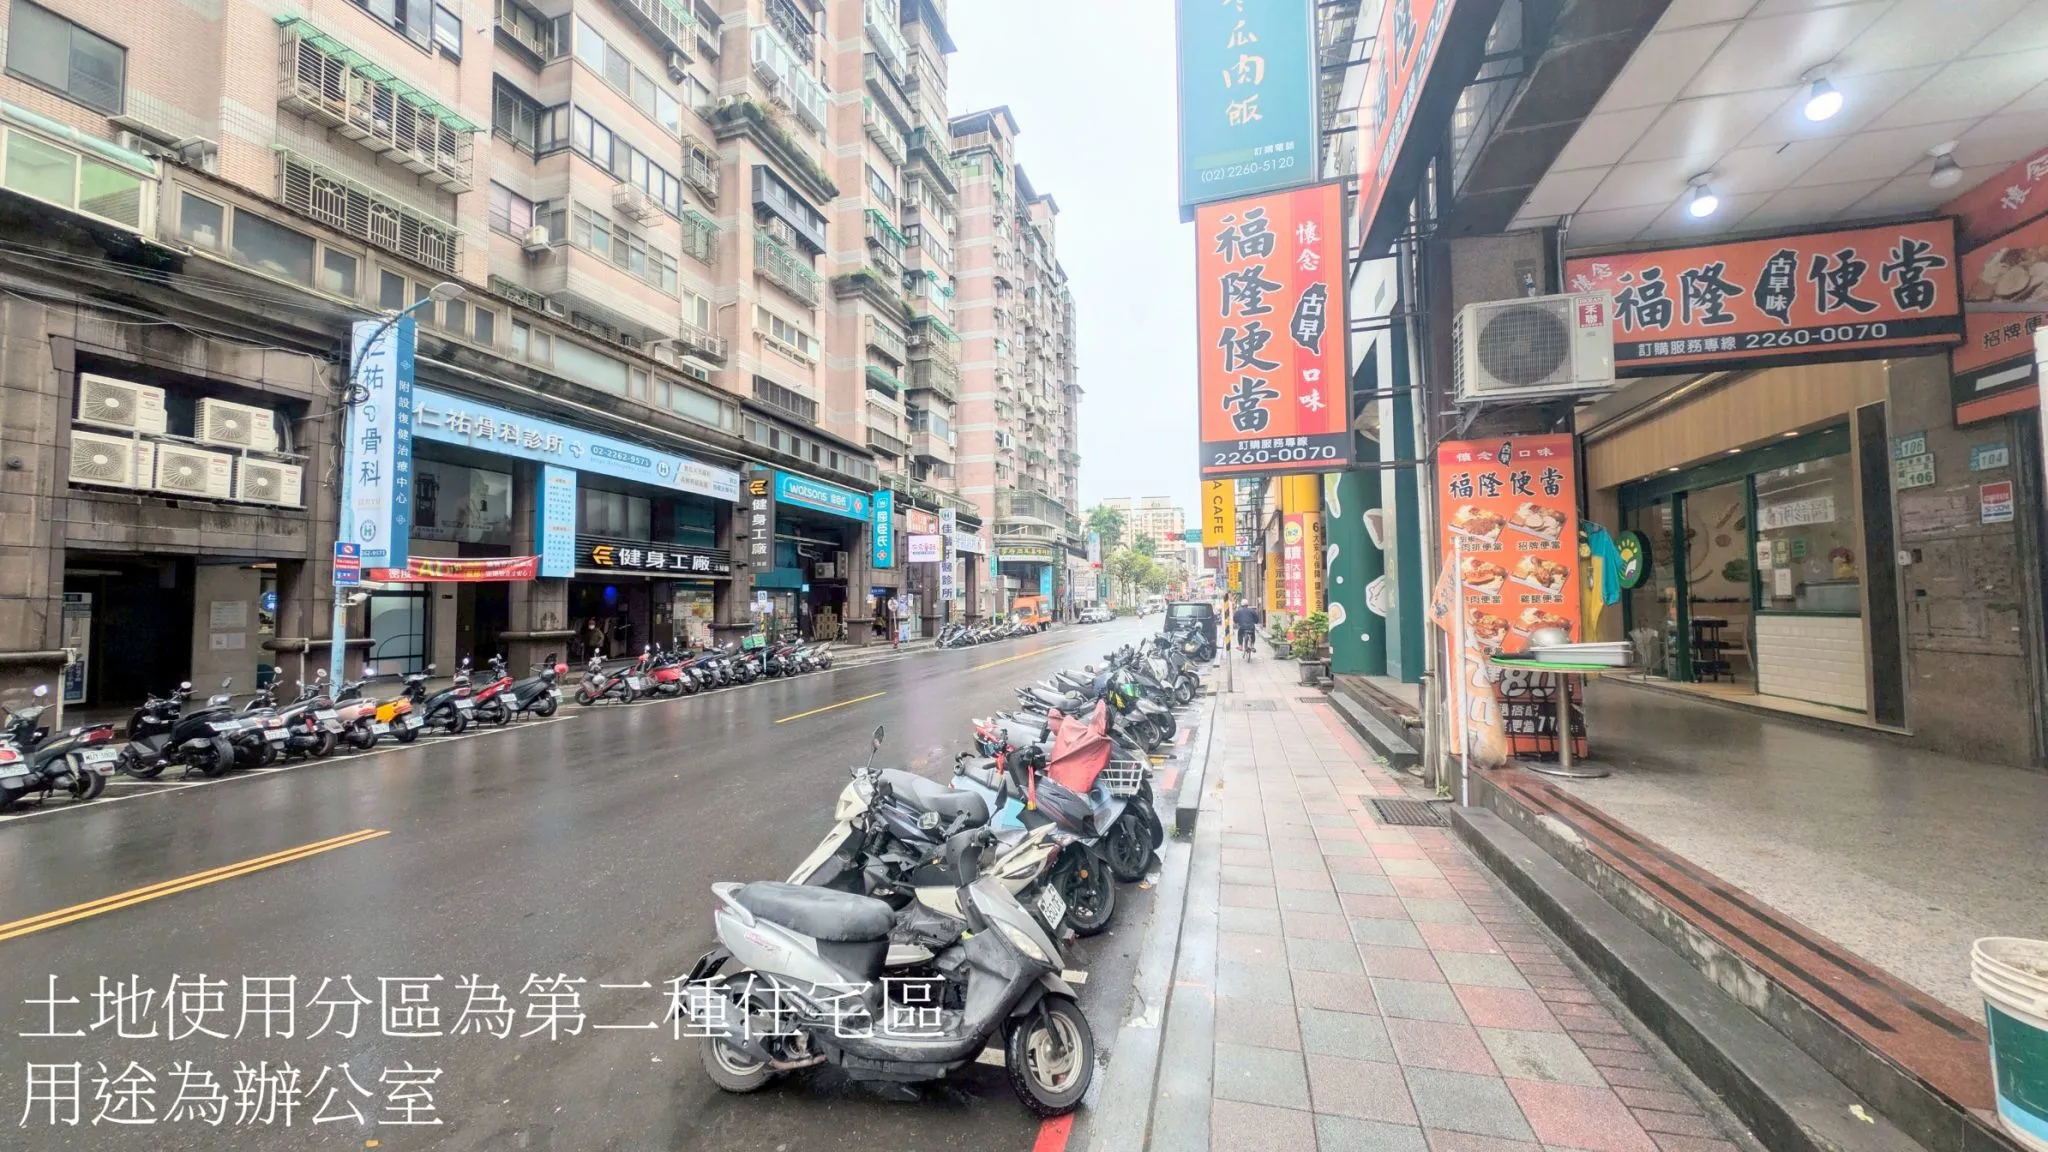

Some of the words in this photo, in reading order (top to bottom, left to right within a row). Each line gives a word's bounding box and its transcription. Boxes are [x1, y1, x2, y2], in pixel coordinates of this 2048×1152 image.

[1254, 141, 1294, 156] 訂購電話
[1201, 156, 1295, 182] (02)2260-5120
[1296, 220, 1321, 271] 懷念
[1614, 261, 1745, 333] 福隆
[1806, 236, 1949, 315] 便當
[1765, 257, 1792, 311] 古早味
[1214, 207, 1284, 432] 福隆便當
[1297, 294, 1324, 341] 古早
[1638, 339, 1736, 358] 訂購服務專線
[1745, 323, 1888, 349] 2260-0070
[1299, 368, 1326, 412] 口味
[413, 401, 564, 456] 仁祐骨科診所
[1215, 446, 1336, 466] 2260-0070
[1238, 437, 1308, 451] 訂購服務專線
[1519, 447, 1555, 457] 口味
[790, 483, 827, 502] watsons
[1448, 467, 1564, 500] 福隆便當
[1909, 471, 1933, 485] 106
[752, 499, 767, 555] 健身工廠
[1213, 495, 1224, 534] CAFE
[618, 547, 711, 572] 健身工廠
